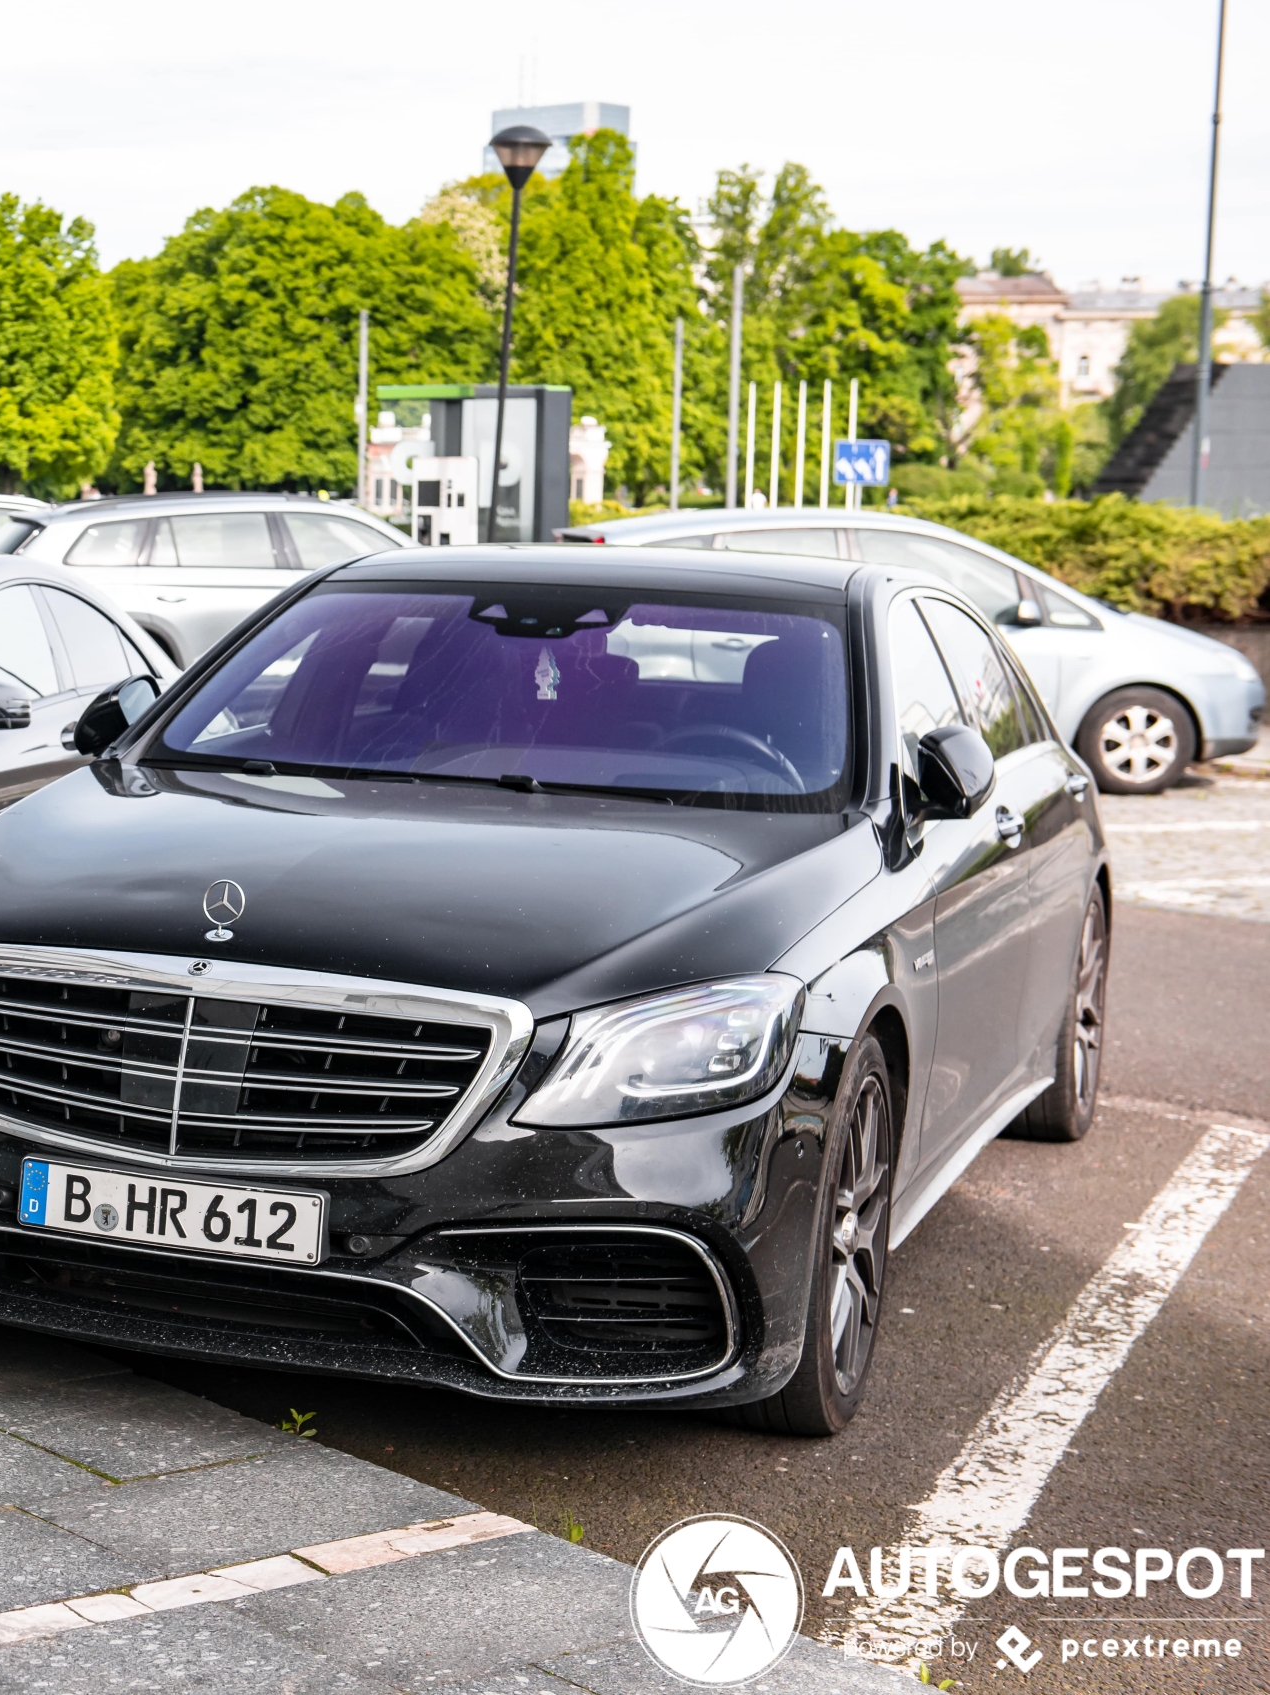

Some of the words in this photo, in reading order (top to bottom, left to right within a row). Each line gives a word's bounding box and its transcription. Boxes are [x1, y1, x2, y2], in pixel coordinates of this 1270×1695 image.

[28, 1199, 38, 1212] D
[64, 1173, 92, 1223] B
[125, 1183, 188, 1239] HR
[202, 1194, 297, 1251] 612
